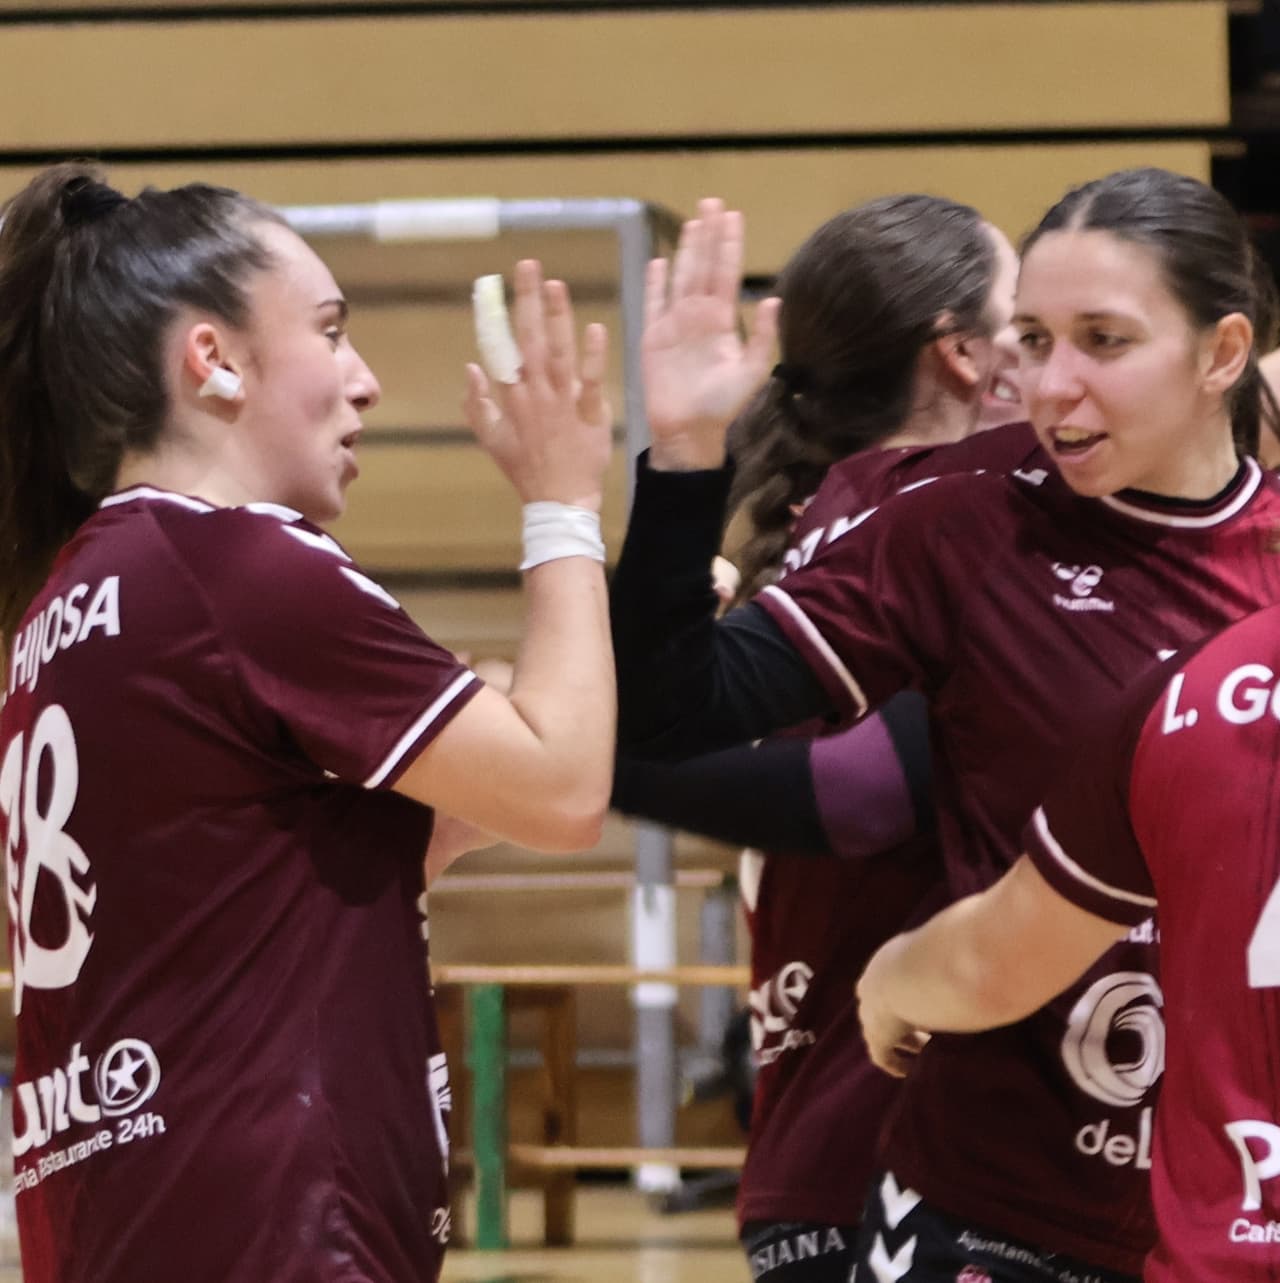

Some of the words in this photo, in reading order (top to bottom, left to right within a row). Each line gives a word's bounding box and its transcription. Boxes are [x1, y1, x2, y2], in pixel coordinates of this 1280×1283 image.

[9, 575, 121, 696] HIJOSA
[1162, 672, 1199, 735] L.
[117, 1112, 166, 1145] 24h
